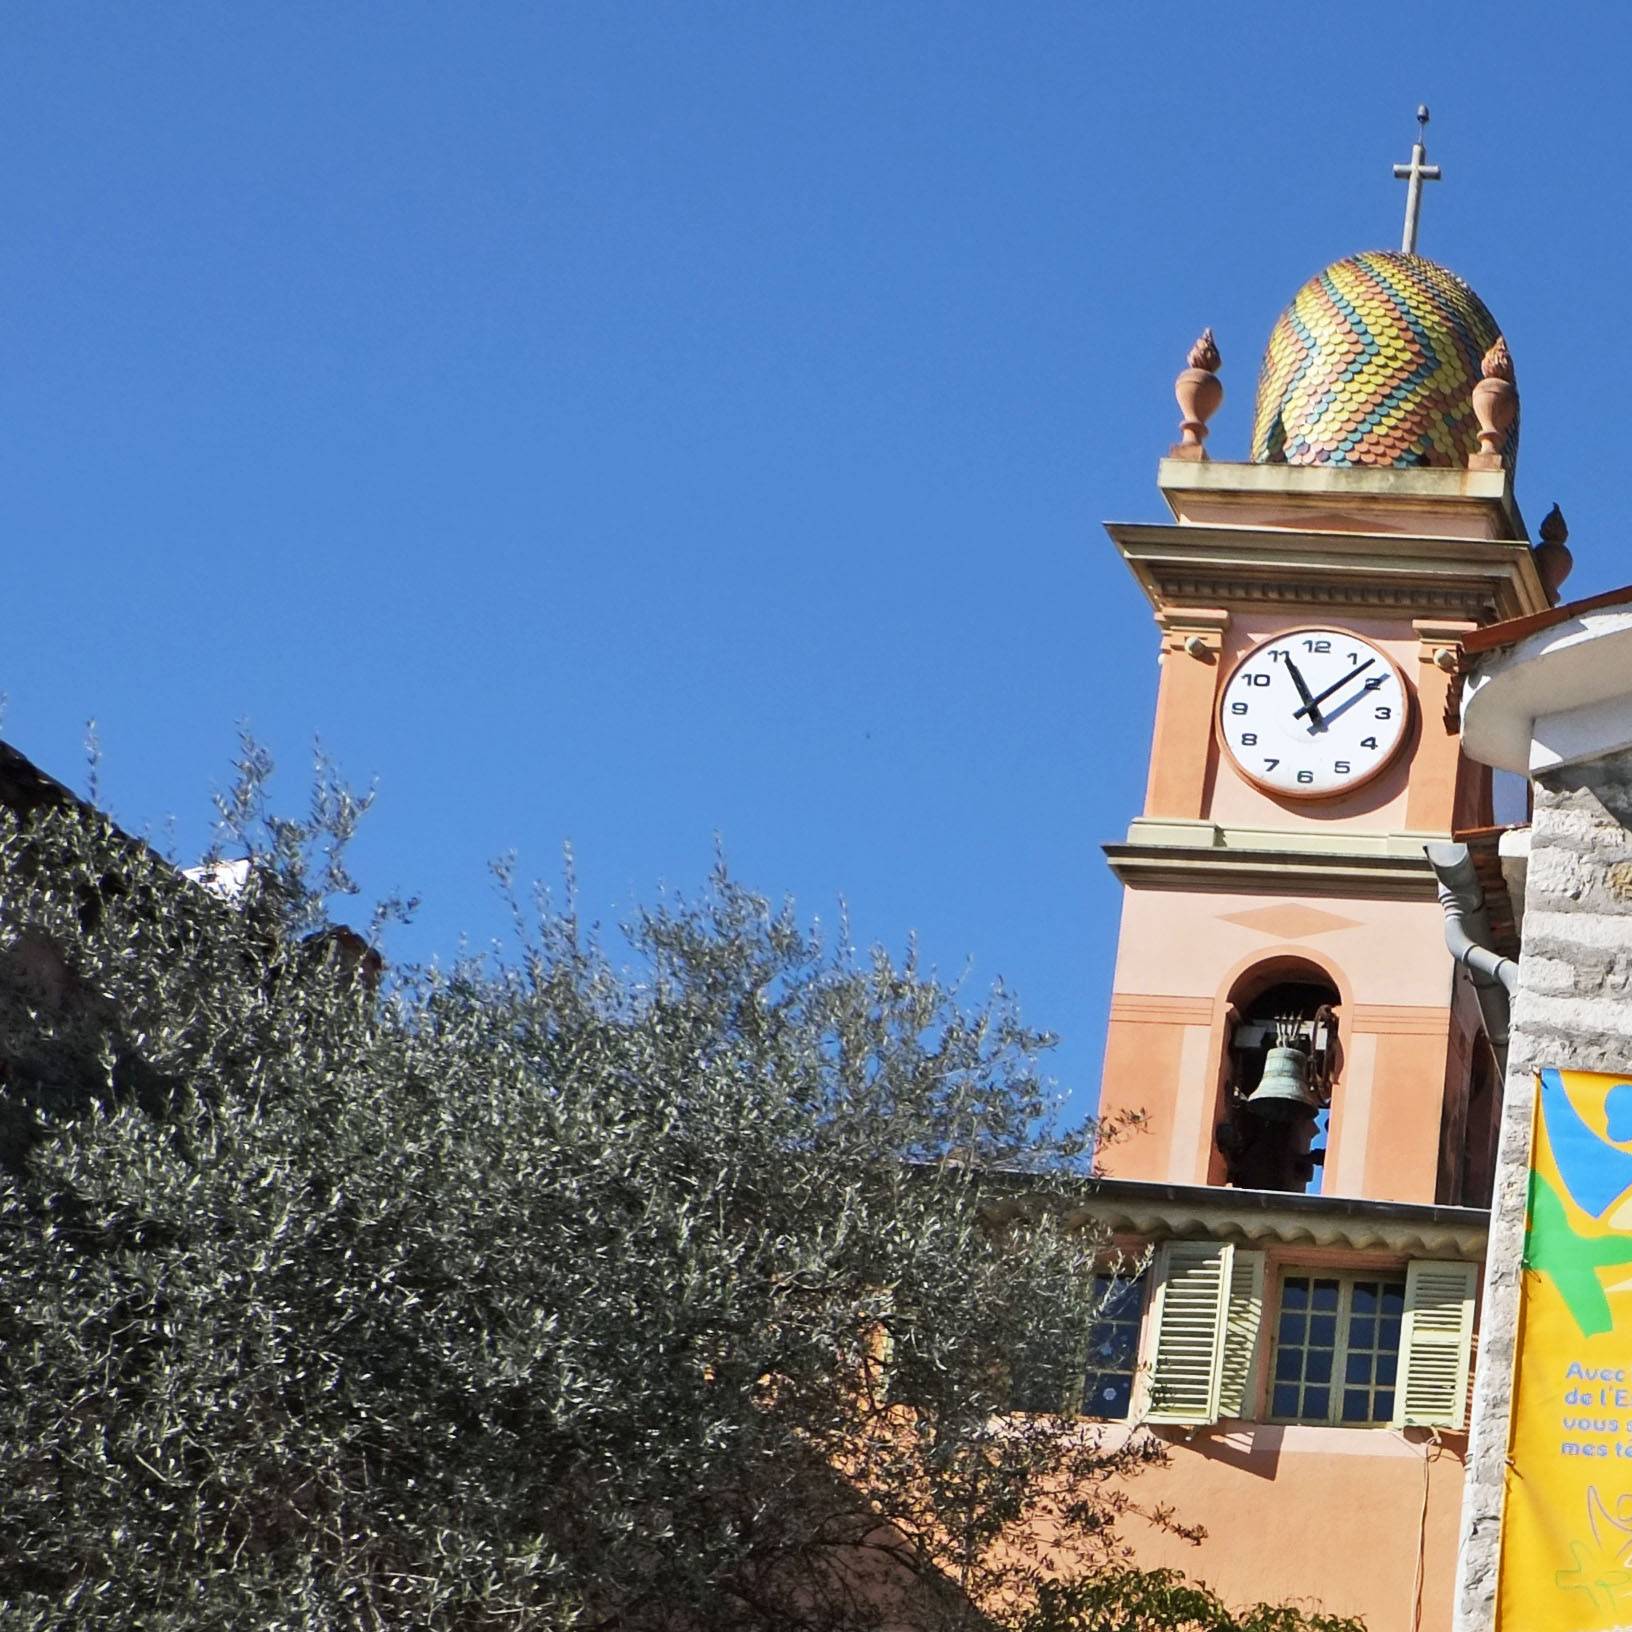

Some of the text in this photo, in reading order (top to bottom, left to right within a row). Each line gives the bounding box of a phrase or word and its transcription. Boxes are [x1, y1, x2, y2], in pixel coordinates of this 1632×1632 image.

[1302, 640, 1331, 653] 12
[1268, 650, 1290, 662] 11
[1347, 652, 1357, 665] 1
[1241, 674, 1270, 687] 10
[1364, 678, 1381, 690] 2
[1231, 702, 1248, 715] 9
[1374, 707, 1391, 719] 3
[1241, 733, 1258, 746] 8
[1360, 736, 1378, 749] 4
[1263, 759, 1280, 771] 7
[1334, 761, 1351, 774] 5
[1297, 771, 1313, 784] 6
[1566, 1361, 1625, 1383] Avec
[1564, 1387, 1593, 1406] de
[1562, 1417, 1619, 1433] vous
[1561, 1441, 1608, 1457] mes
